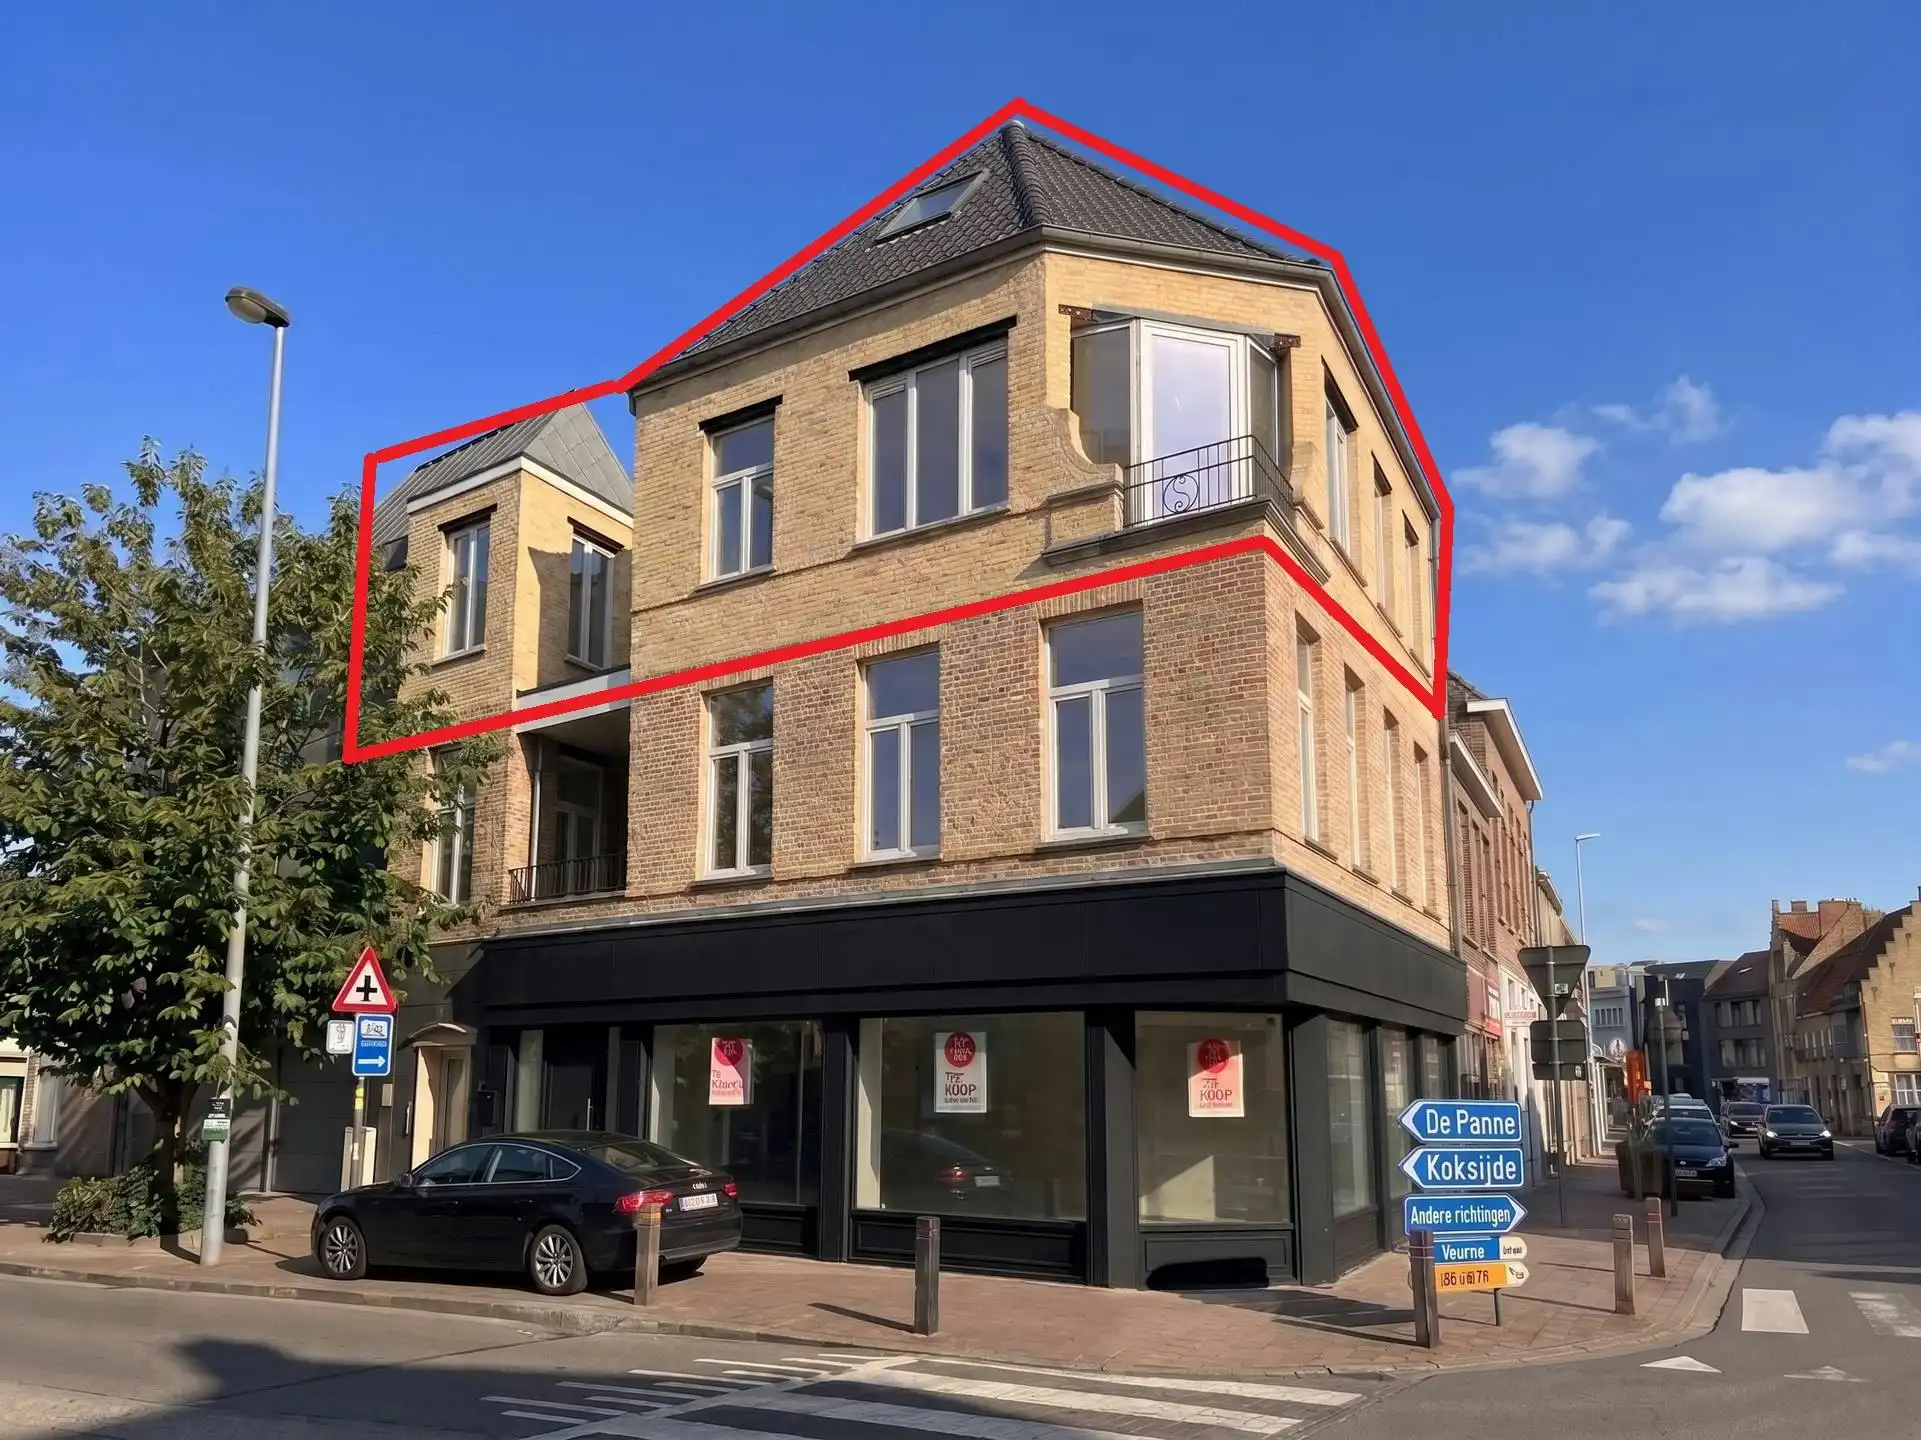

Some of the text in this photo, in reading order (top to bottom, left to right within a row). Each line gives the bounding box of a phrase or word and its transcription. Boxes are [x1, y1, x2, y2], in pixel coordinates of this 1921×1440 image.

[1200, 1089, 1233, 1101] KOOP
[1425, 1109, 1516, 1135] De Panne
[1427, 1153, 1517, 1185] Koksijde
[1410, 1205, 1511, 1228] Andere richtingen
[1441, 1244, 1485, 1260] Veurne
